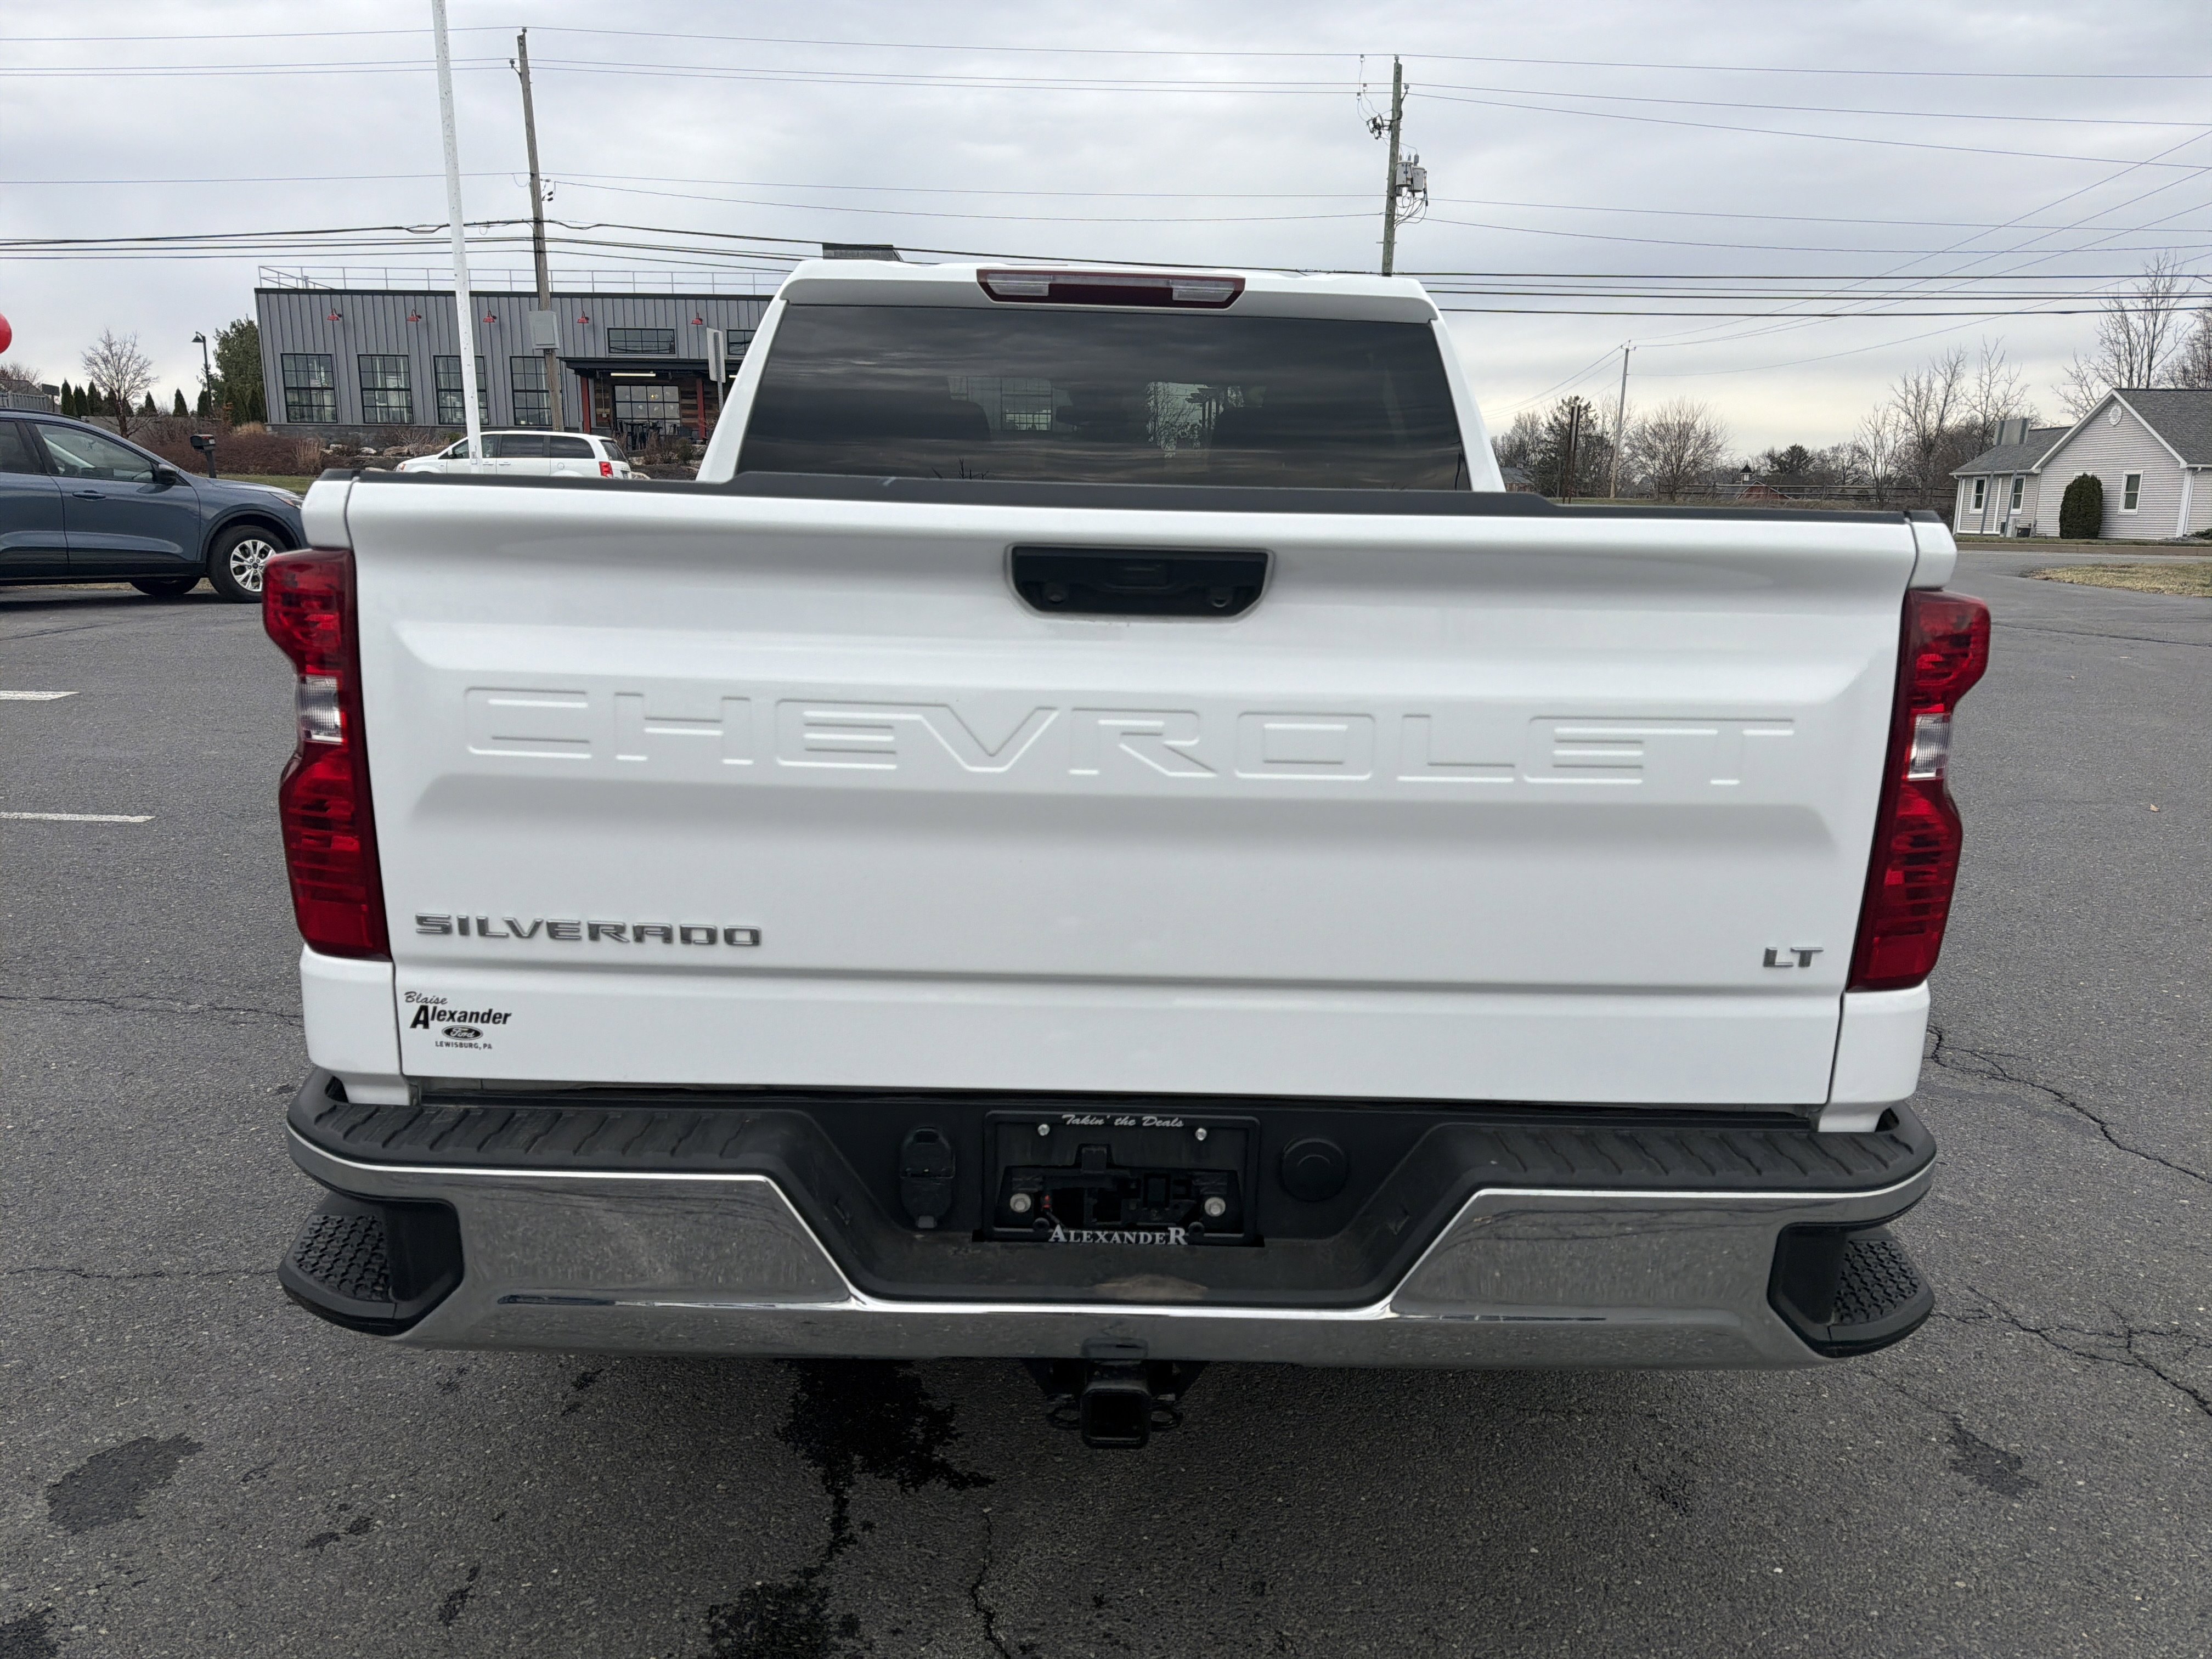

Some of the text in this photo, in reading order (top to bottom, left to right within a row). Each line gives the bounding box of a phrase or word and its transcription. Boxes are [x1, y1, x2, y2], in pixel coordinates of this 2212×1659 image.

[465, 686, 1795, 785] CHEVROLET
[415, 913, 761, 946] SILVERADO
[1763, 947, 1824, 968] LT
[404, 991, 448, 1005] Blaise
[409, 1005, 512, 1029] Alexander
[450, 1027, 475, 1038] Ford
[435, 1041, 482, 1051] LEWISBURG,
[1114, 1116, 1136, 1126] the
[1142, 1116, 1184, 1127] Deals
[1048, 1224, 1188, 1245] ALEXANDER
